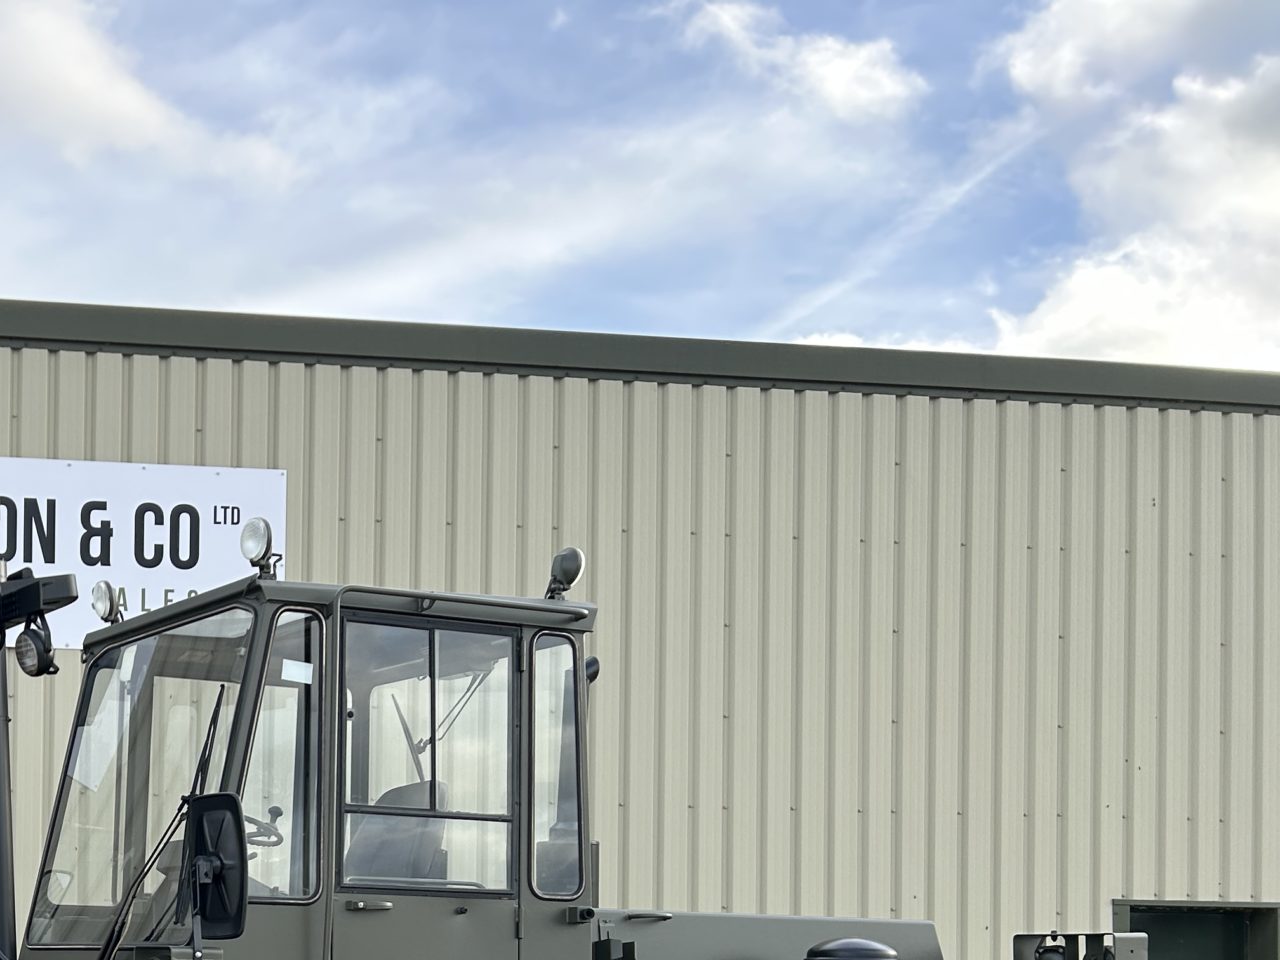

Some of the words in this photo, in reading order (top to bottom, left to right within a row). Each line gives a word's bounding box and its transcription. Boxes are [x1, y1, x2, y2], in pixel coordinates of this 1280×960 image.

[79, 500, 114, 567] &
[133, 502, 200, 570] CO
[213, 505, 241, 526] LTD
